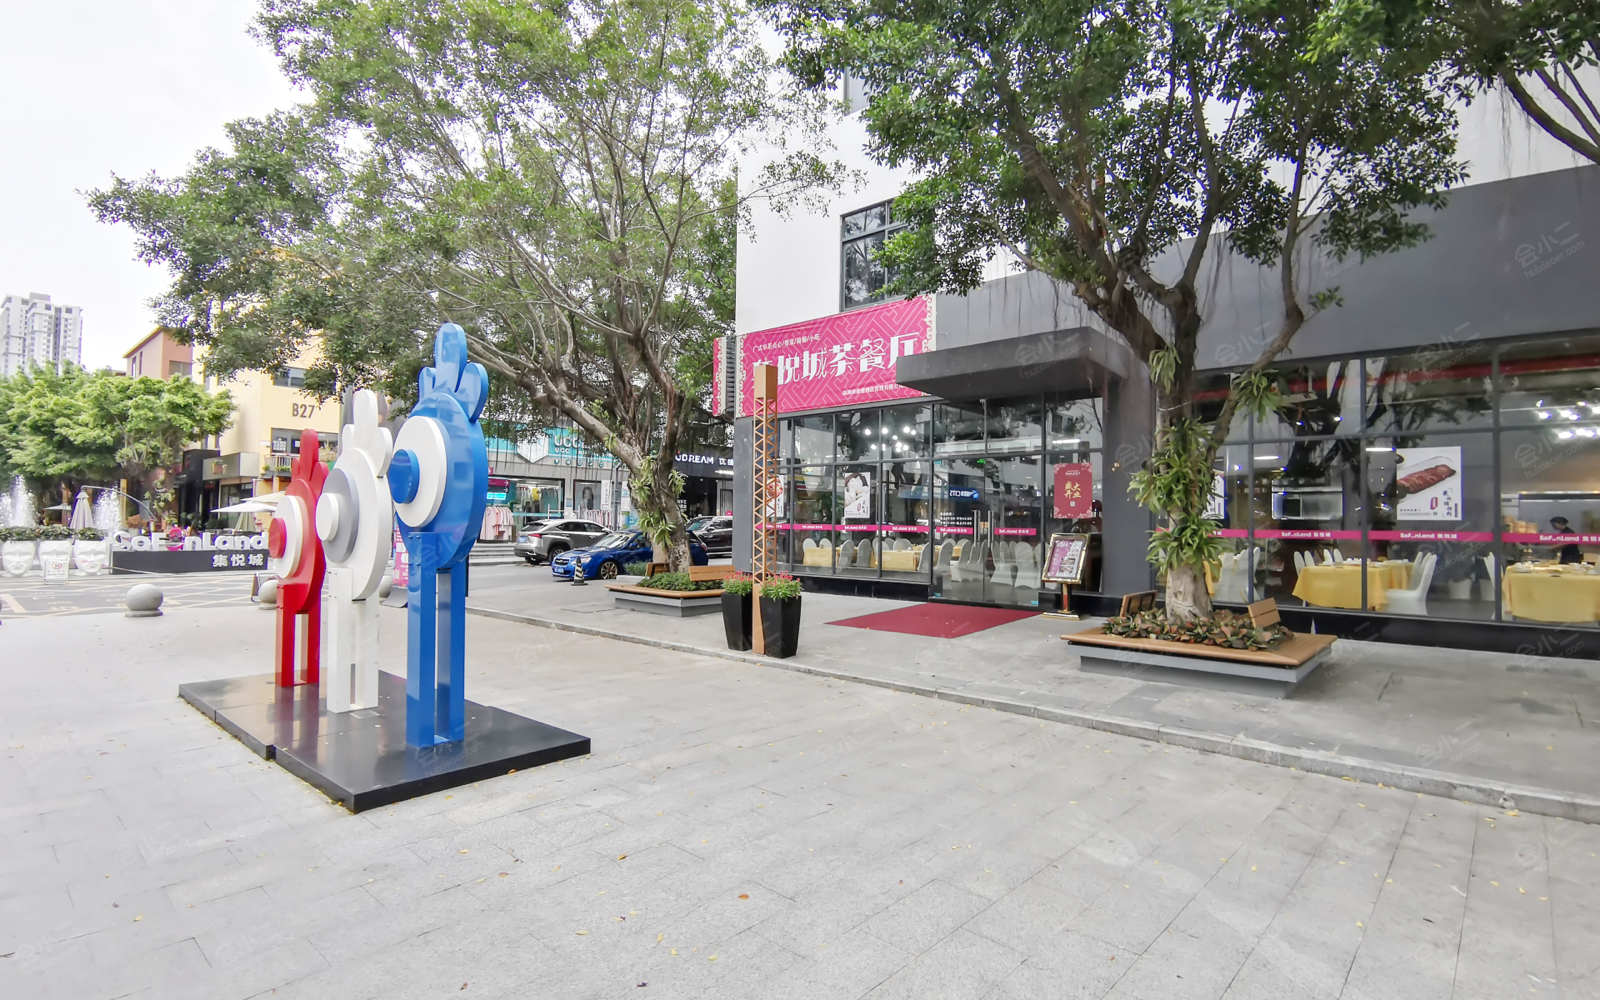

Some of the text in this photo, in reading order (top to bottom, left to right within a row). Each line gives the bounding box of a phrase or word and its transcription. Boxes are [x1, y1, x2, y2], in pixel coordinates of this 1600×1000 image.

[751, 331, 919, 389] 悦城茶餐厅
[292, 402, 315, 419] B27
[212, 554, 263, 567] 集悦城
